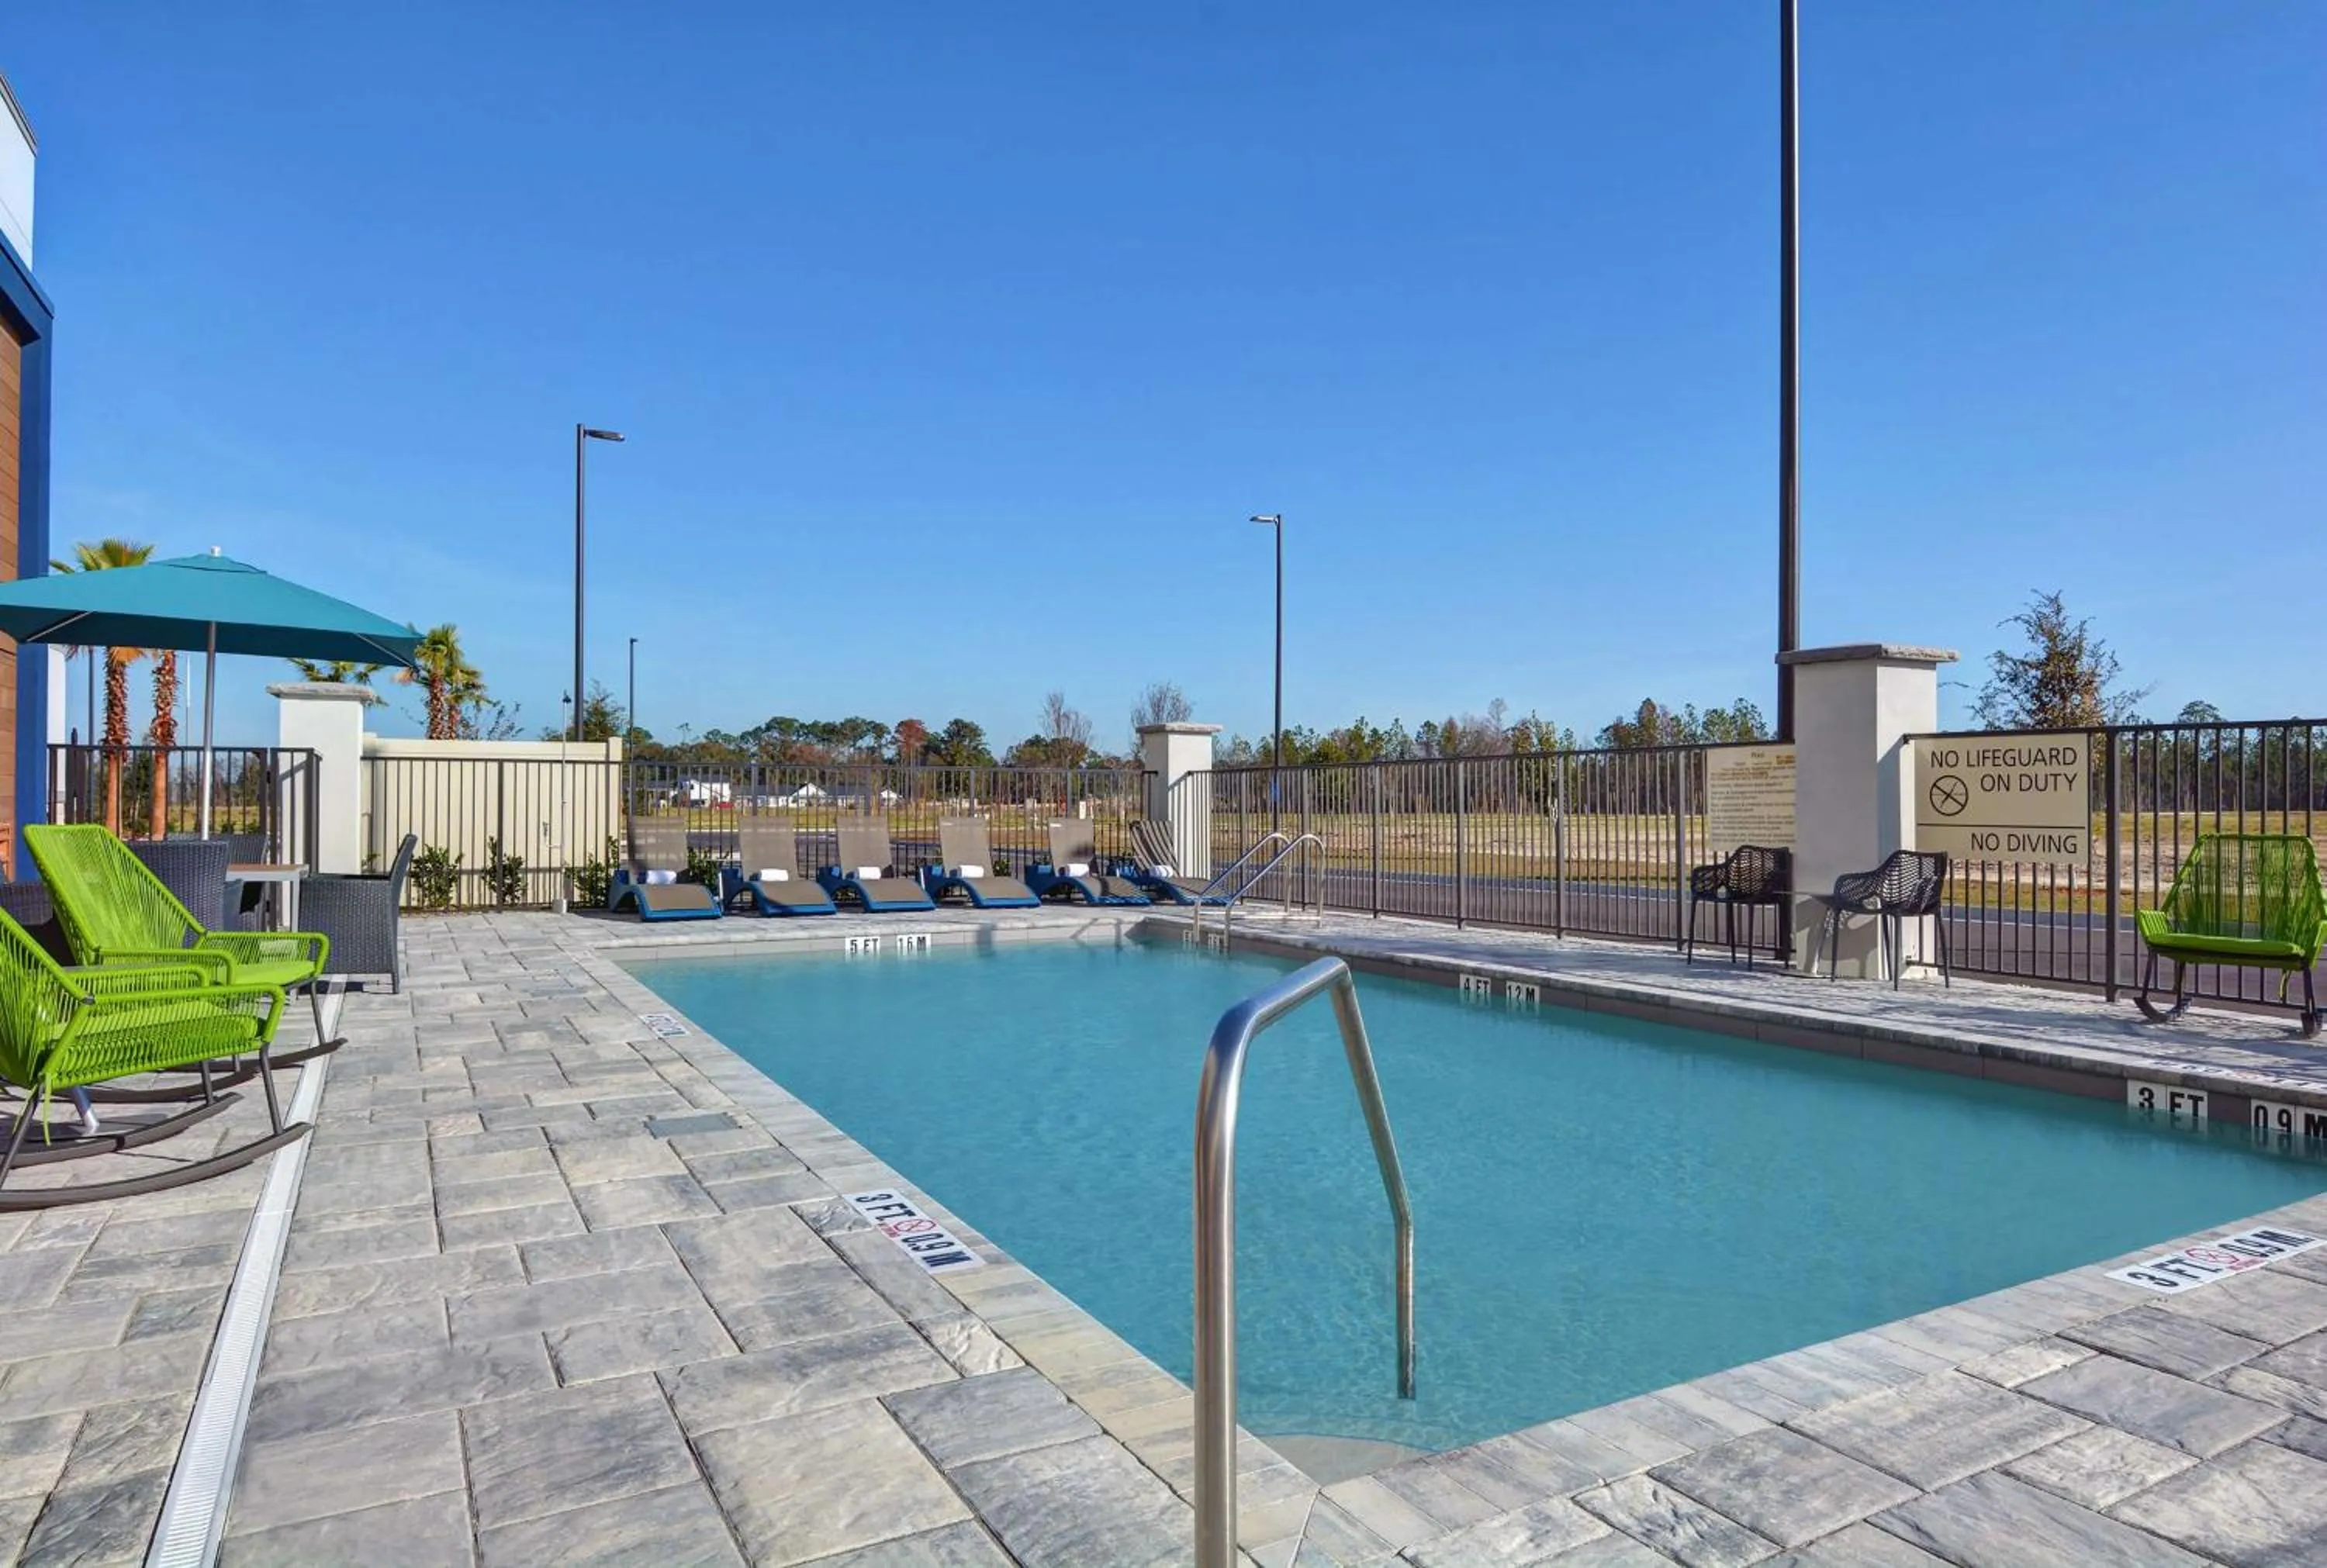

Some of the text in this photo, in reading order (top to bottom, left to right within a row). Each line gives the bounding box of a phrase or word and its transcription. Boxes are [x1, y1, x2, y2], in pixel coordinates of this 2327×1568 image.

[1931, 747, 2077, 768] NO LIFEGUARD
[1980, 772, 2078, 792] ON DUTY
[1971, 832, 2077, 854] NO DIVING
[864, 938, 878, 952] FT
[917, 936, 926, 950] M
[1477, 979, 1489, 993] FT
[1526, 986, 1535, 1002] M
[2139, 1087, 2155, 1109] 3
[2170, 1091, 2204, 1117] FT
[855, 1193, 894, 1203] 3
[2127, 1272, 2179, 1287] 3
